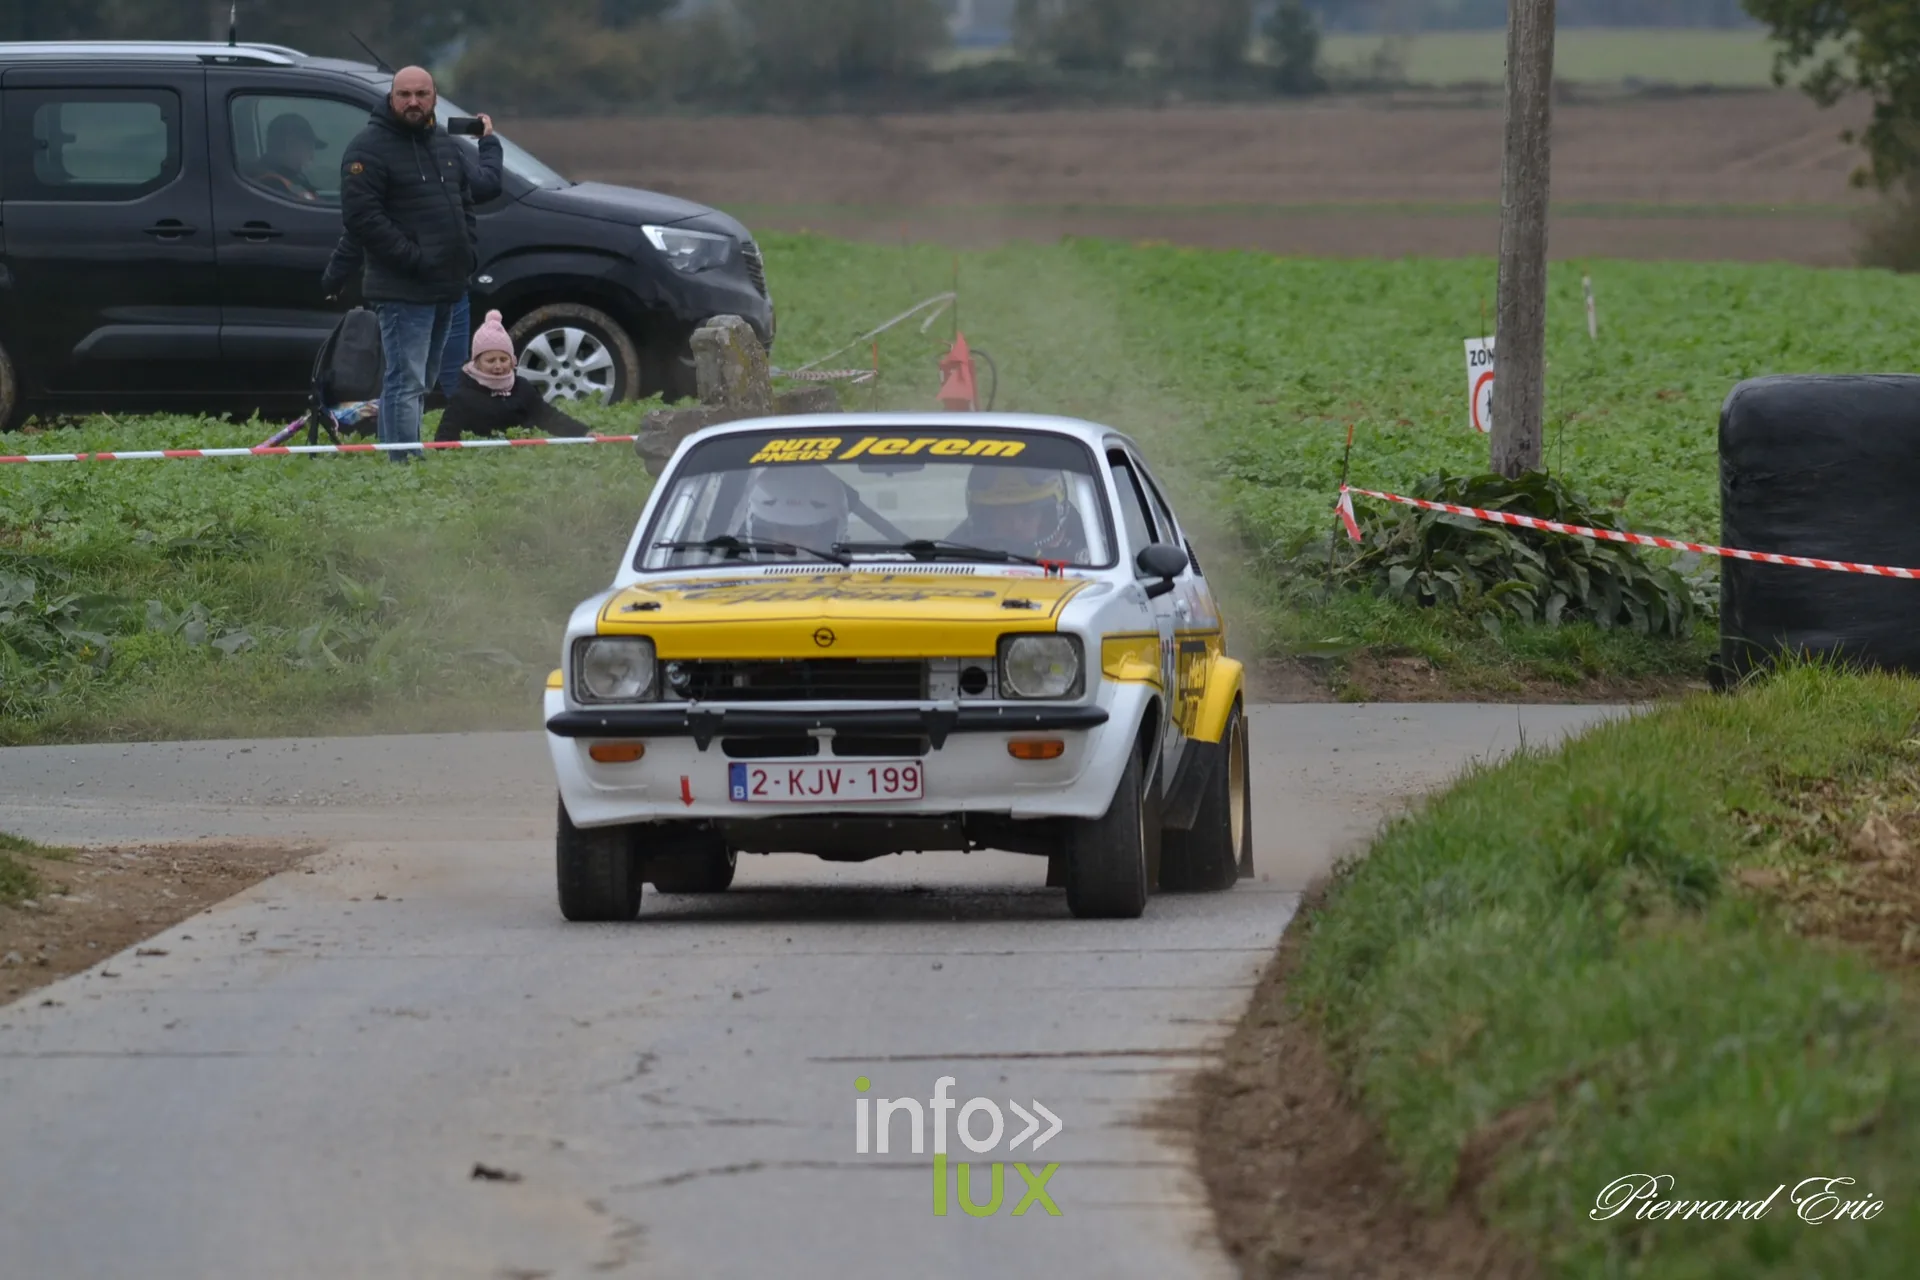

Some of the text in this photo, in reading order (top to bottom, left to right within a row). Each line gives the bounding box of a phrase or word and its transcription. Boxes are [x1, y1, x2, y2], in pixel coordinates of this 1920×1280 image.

[1469, 348, 1495, 367] ZON
[761, 437, 842, 452] AUTO
[837, 436, 1026, 460] Jerem
[749, 450, 833, 463] PNEUS
[733, 767, 919, 798] B 2-KJV-199
